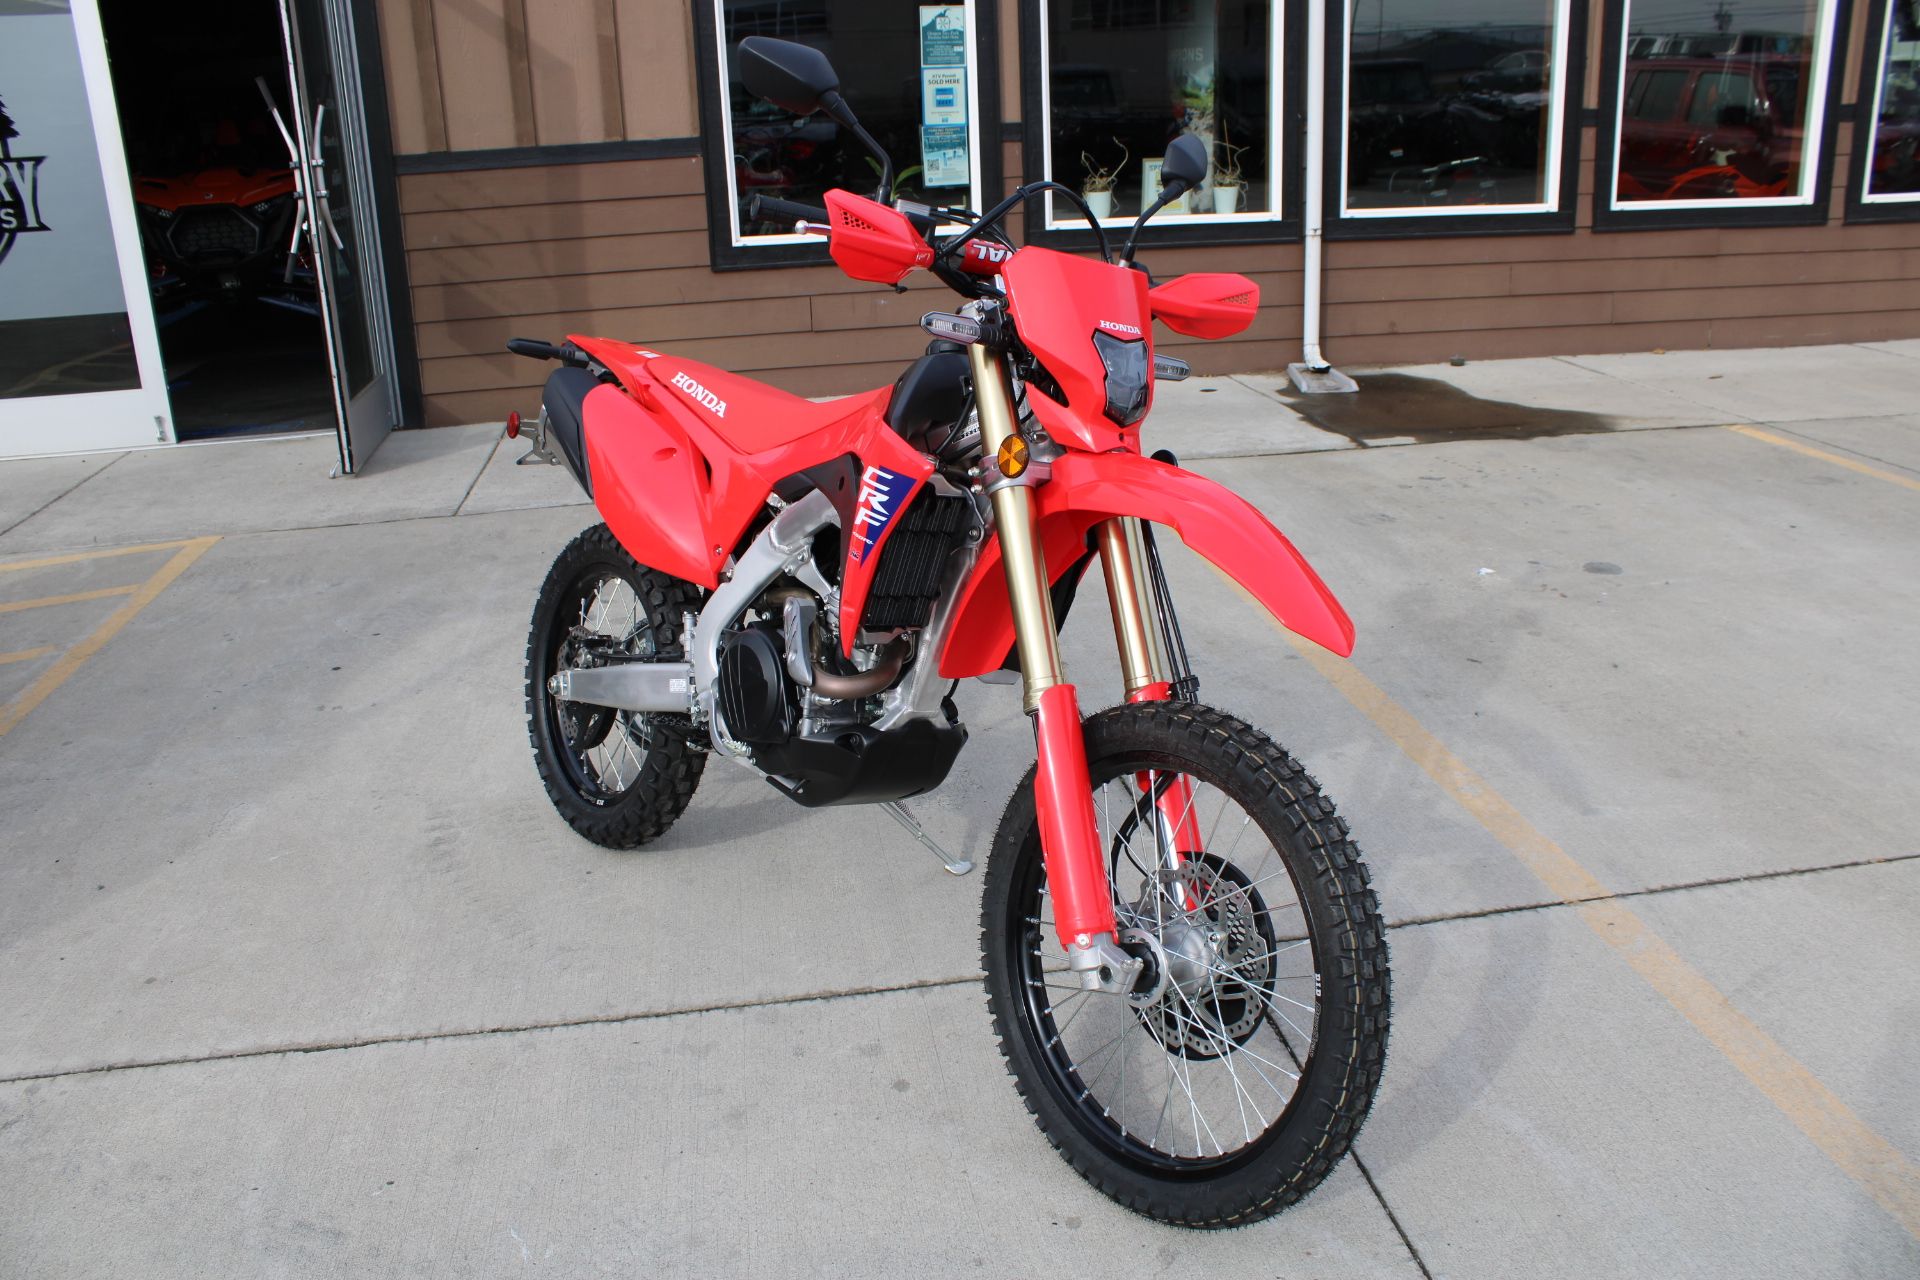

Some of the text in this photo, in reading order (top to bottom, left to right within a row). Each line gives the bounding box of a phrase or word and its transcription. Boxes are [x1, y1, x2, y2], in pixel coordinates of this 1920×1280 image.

[1099, 319, 1142, 335] HONDA
[671, 371, 727, 418] HONDA
[854, 465, 895, 527] CRF
